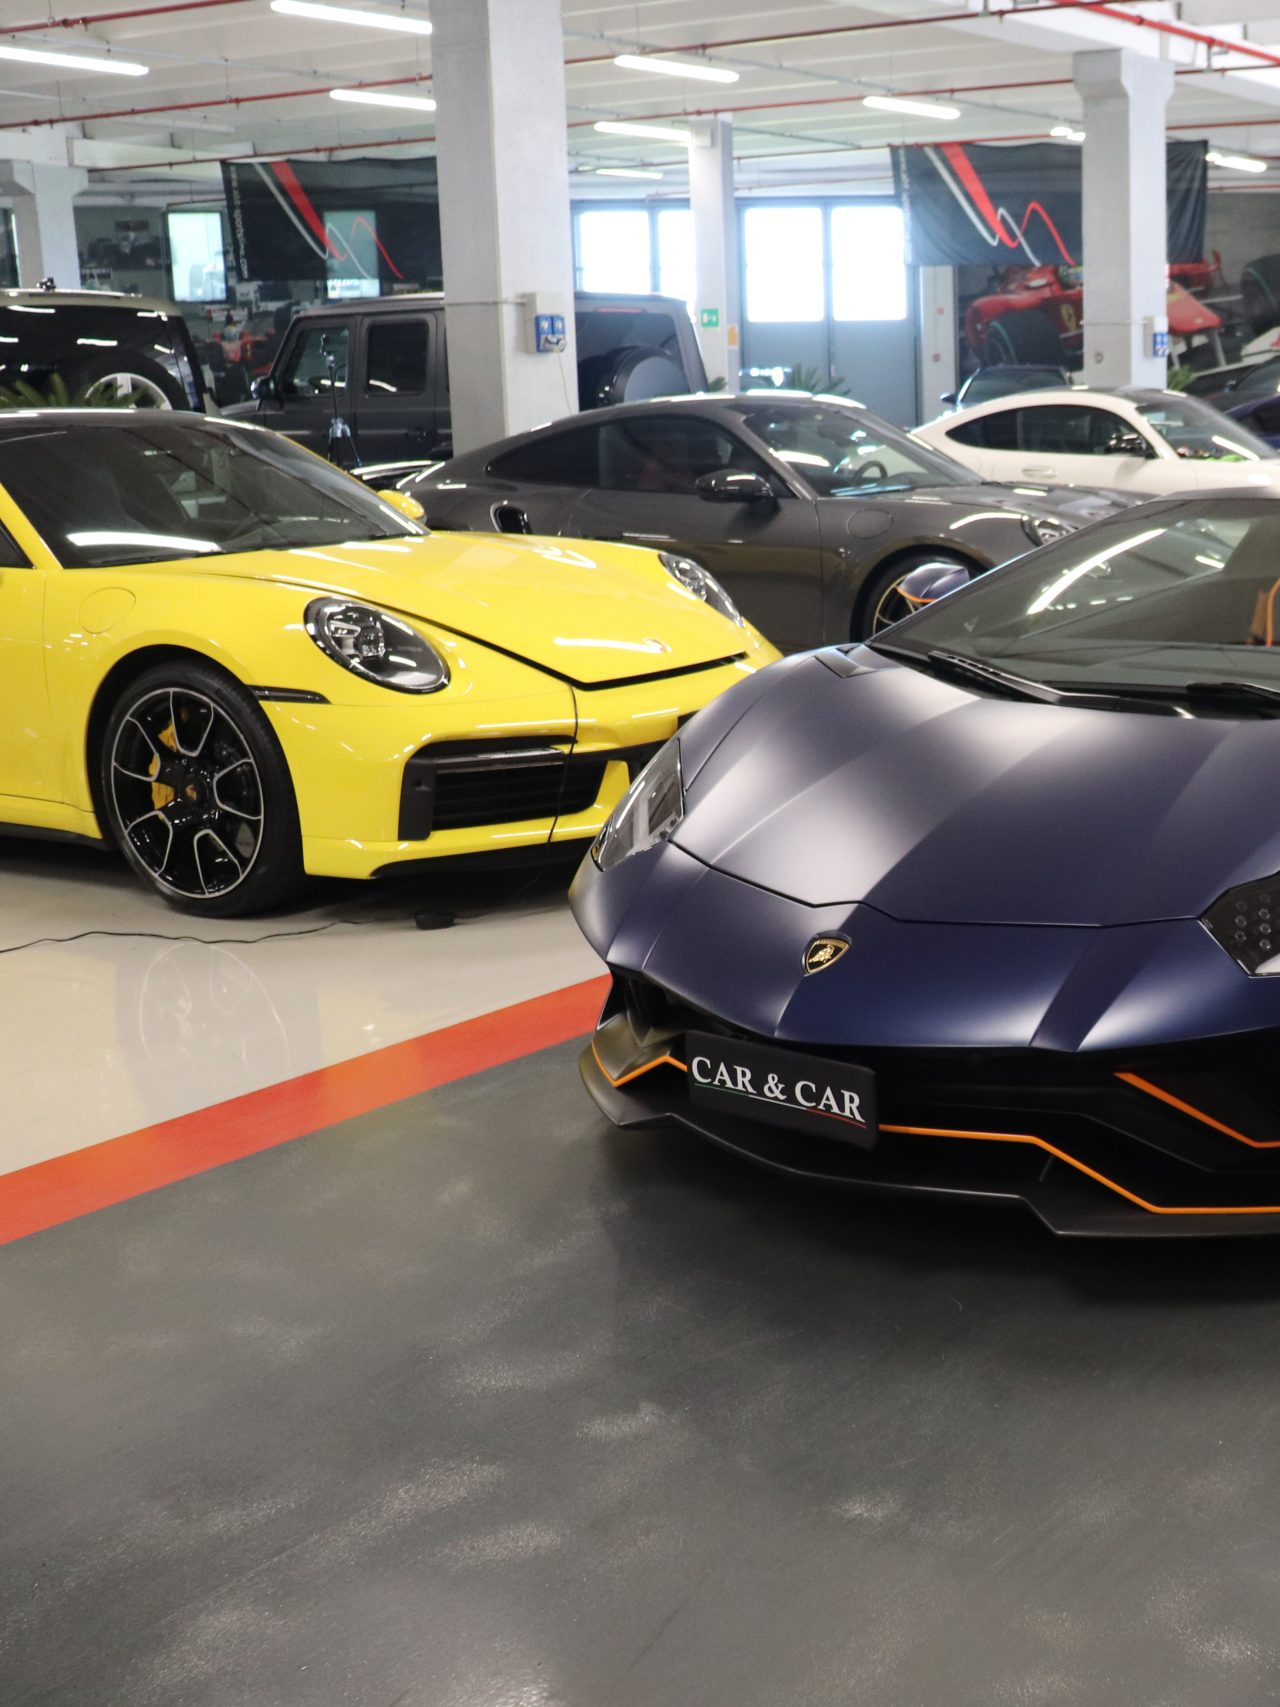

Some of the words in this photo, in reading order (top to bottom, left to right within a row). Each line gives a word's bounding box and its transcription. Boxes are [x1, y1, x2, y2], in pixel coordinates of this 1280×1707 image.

[691, 1056, 757, 1094] CAR
[763, 1073, 787, 1101] &
[794, 1080, 866, 1123] CAR
